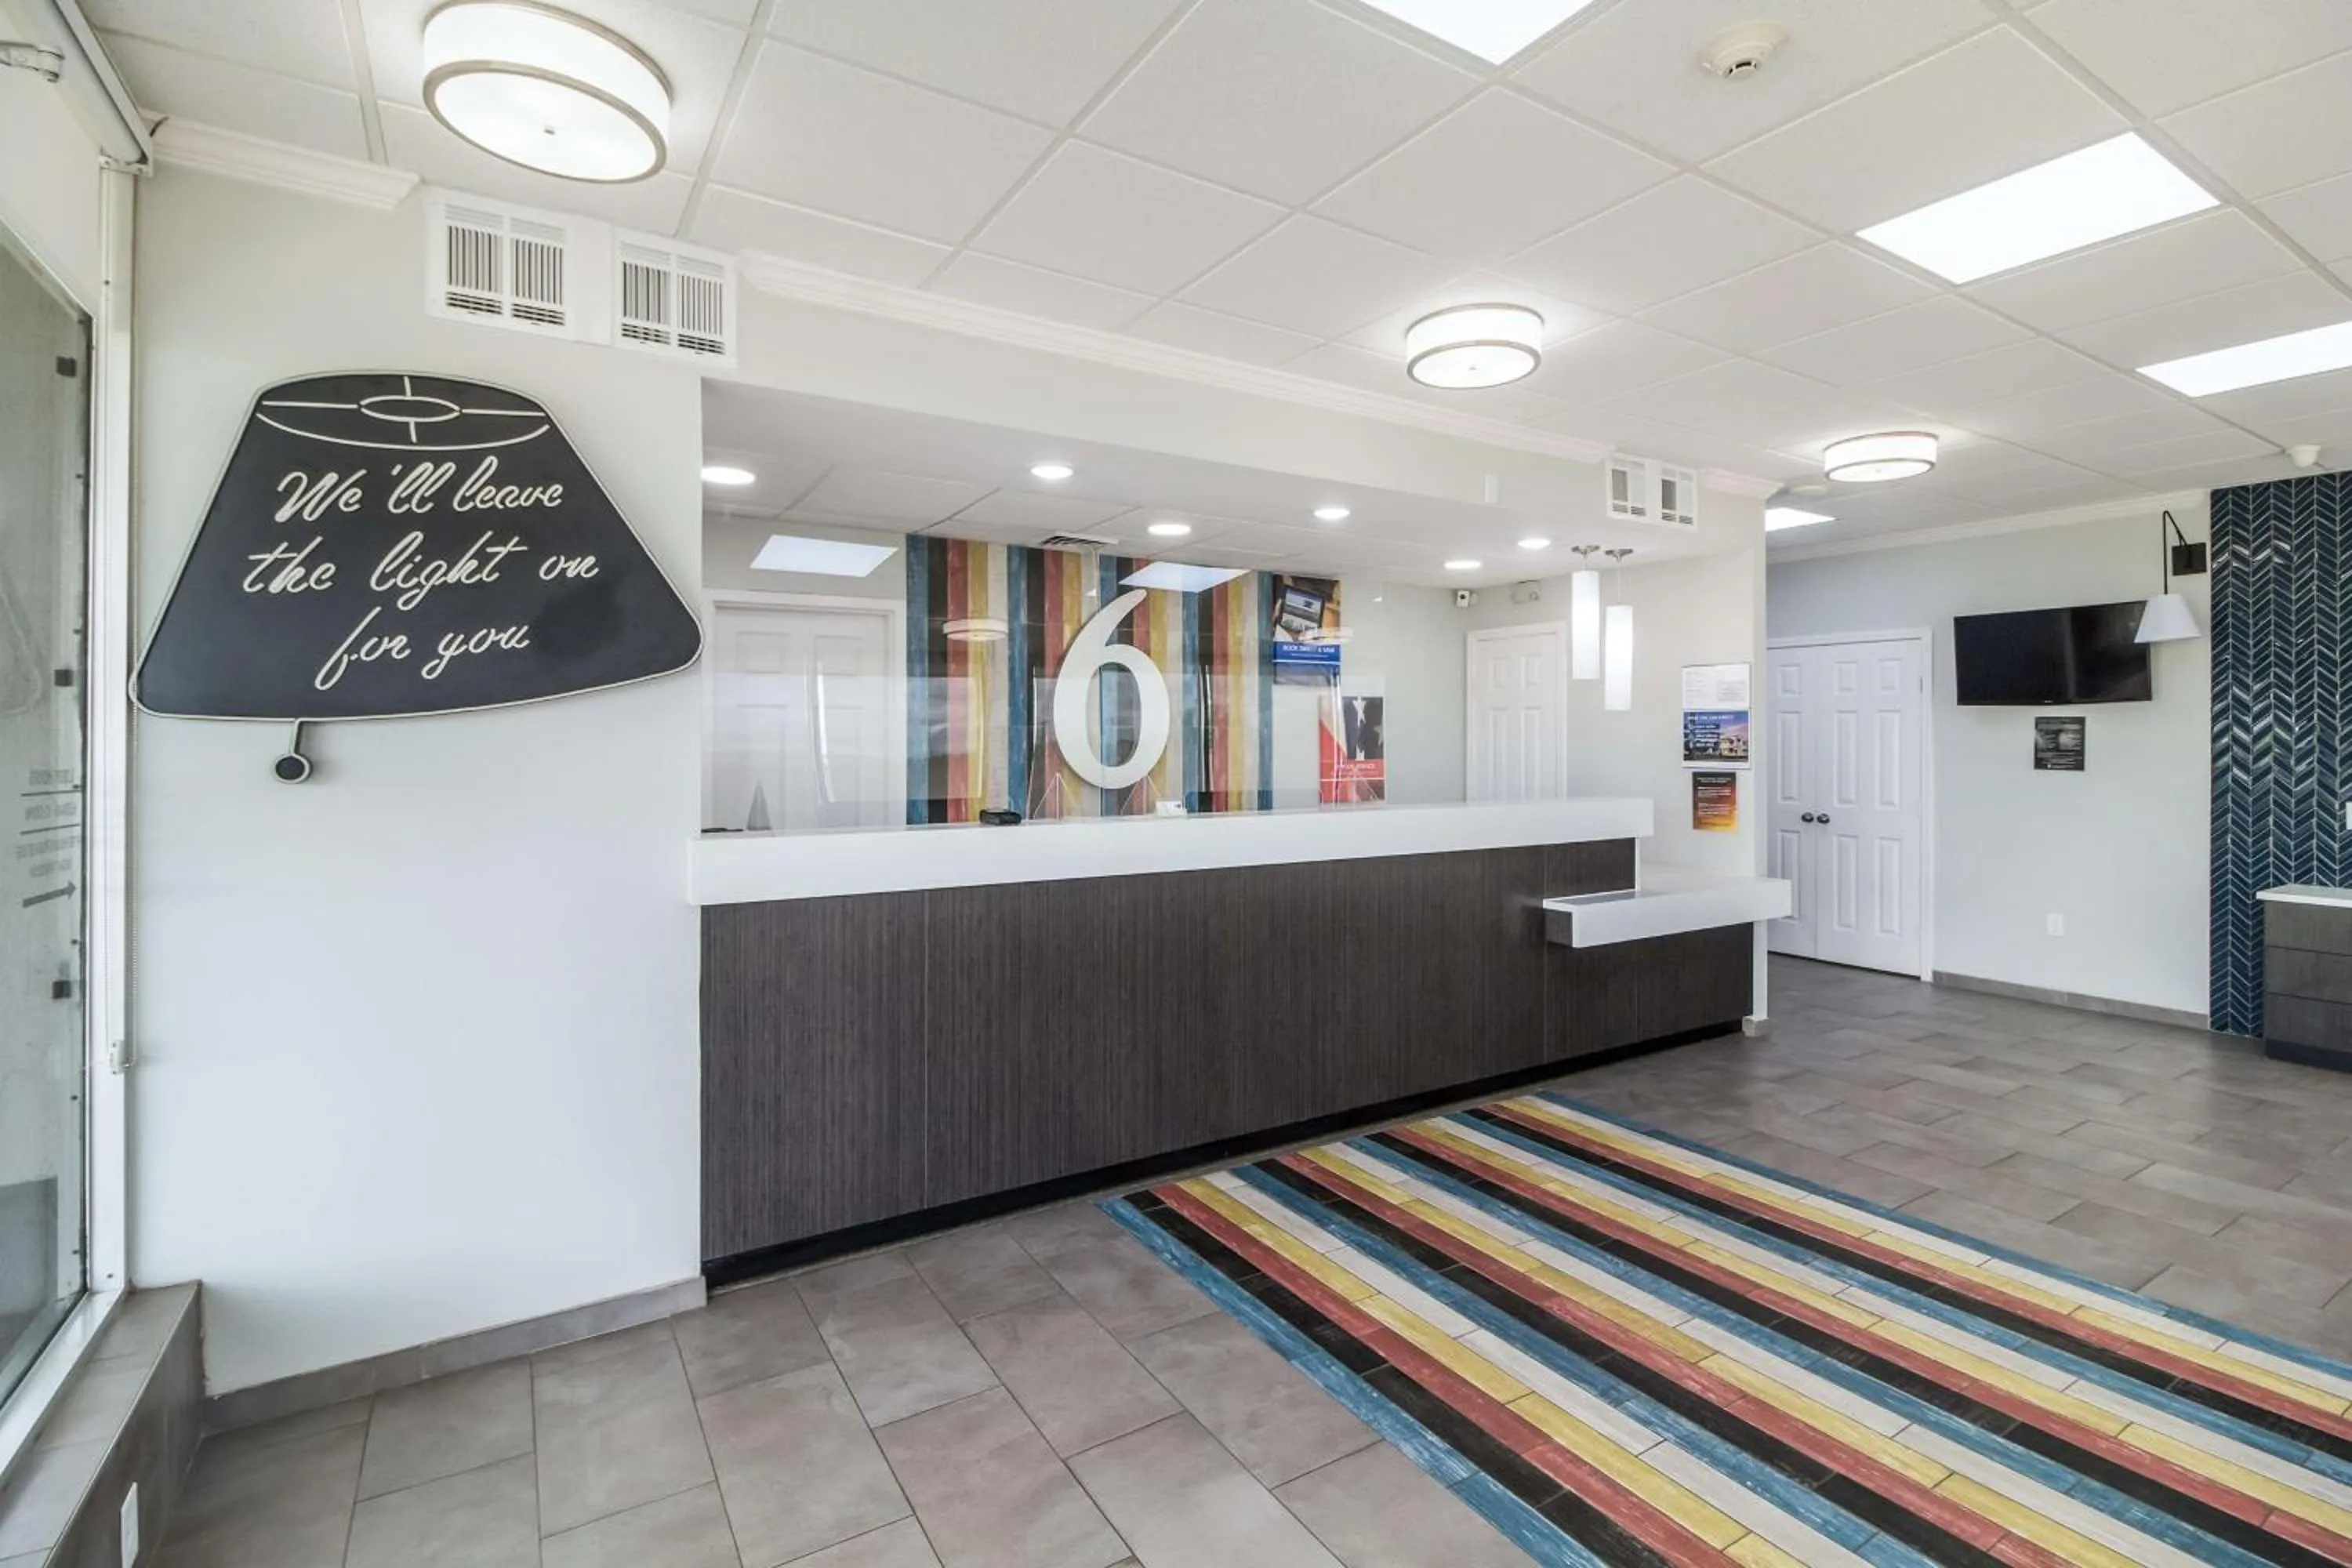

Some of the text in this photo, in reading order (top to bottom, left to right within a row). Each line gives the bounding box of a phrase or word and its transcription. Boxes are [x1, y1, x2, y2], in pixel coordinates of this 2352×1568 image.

[452, 455, 564, 512] leave
[242, 530, 600, 612] the light on
[314, 606, 530, 691] for you
[1054, 589, 1171, 789] 6
